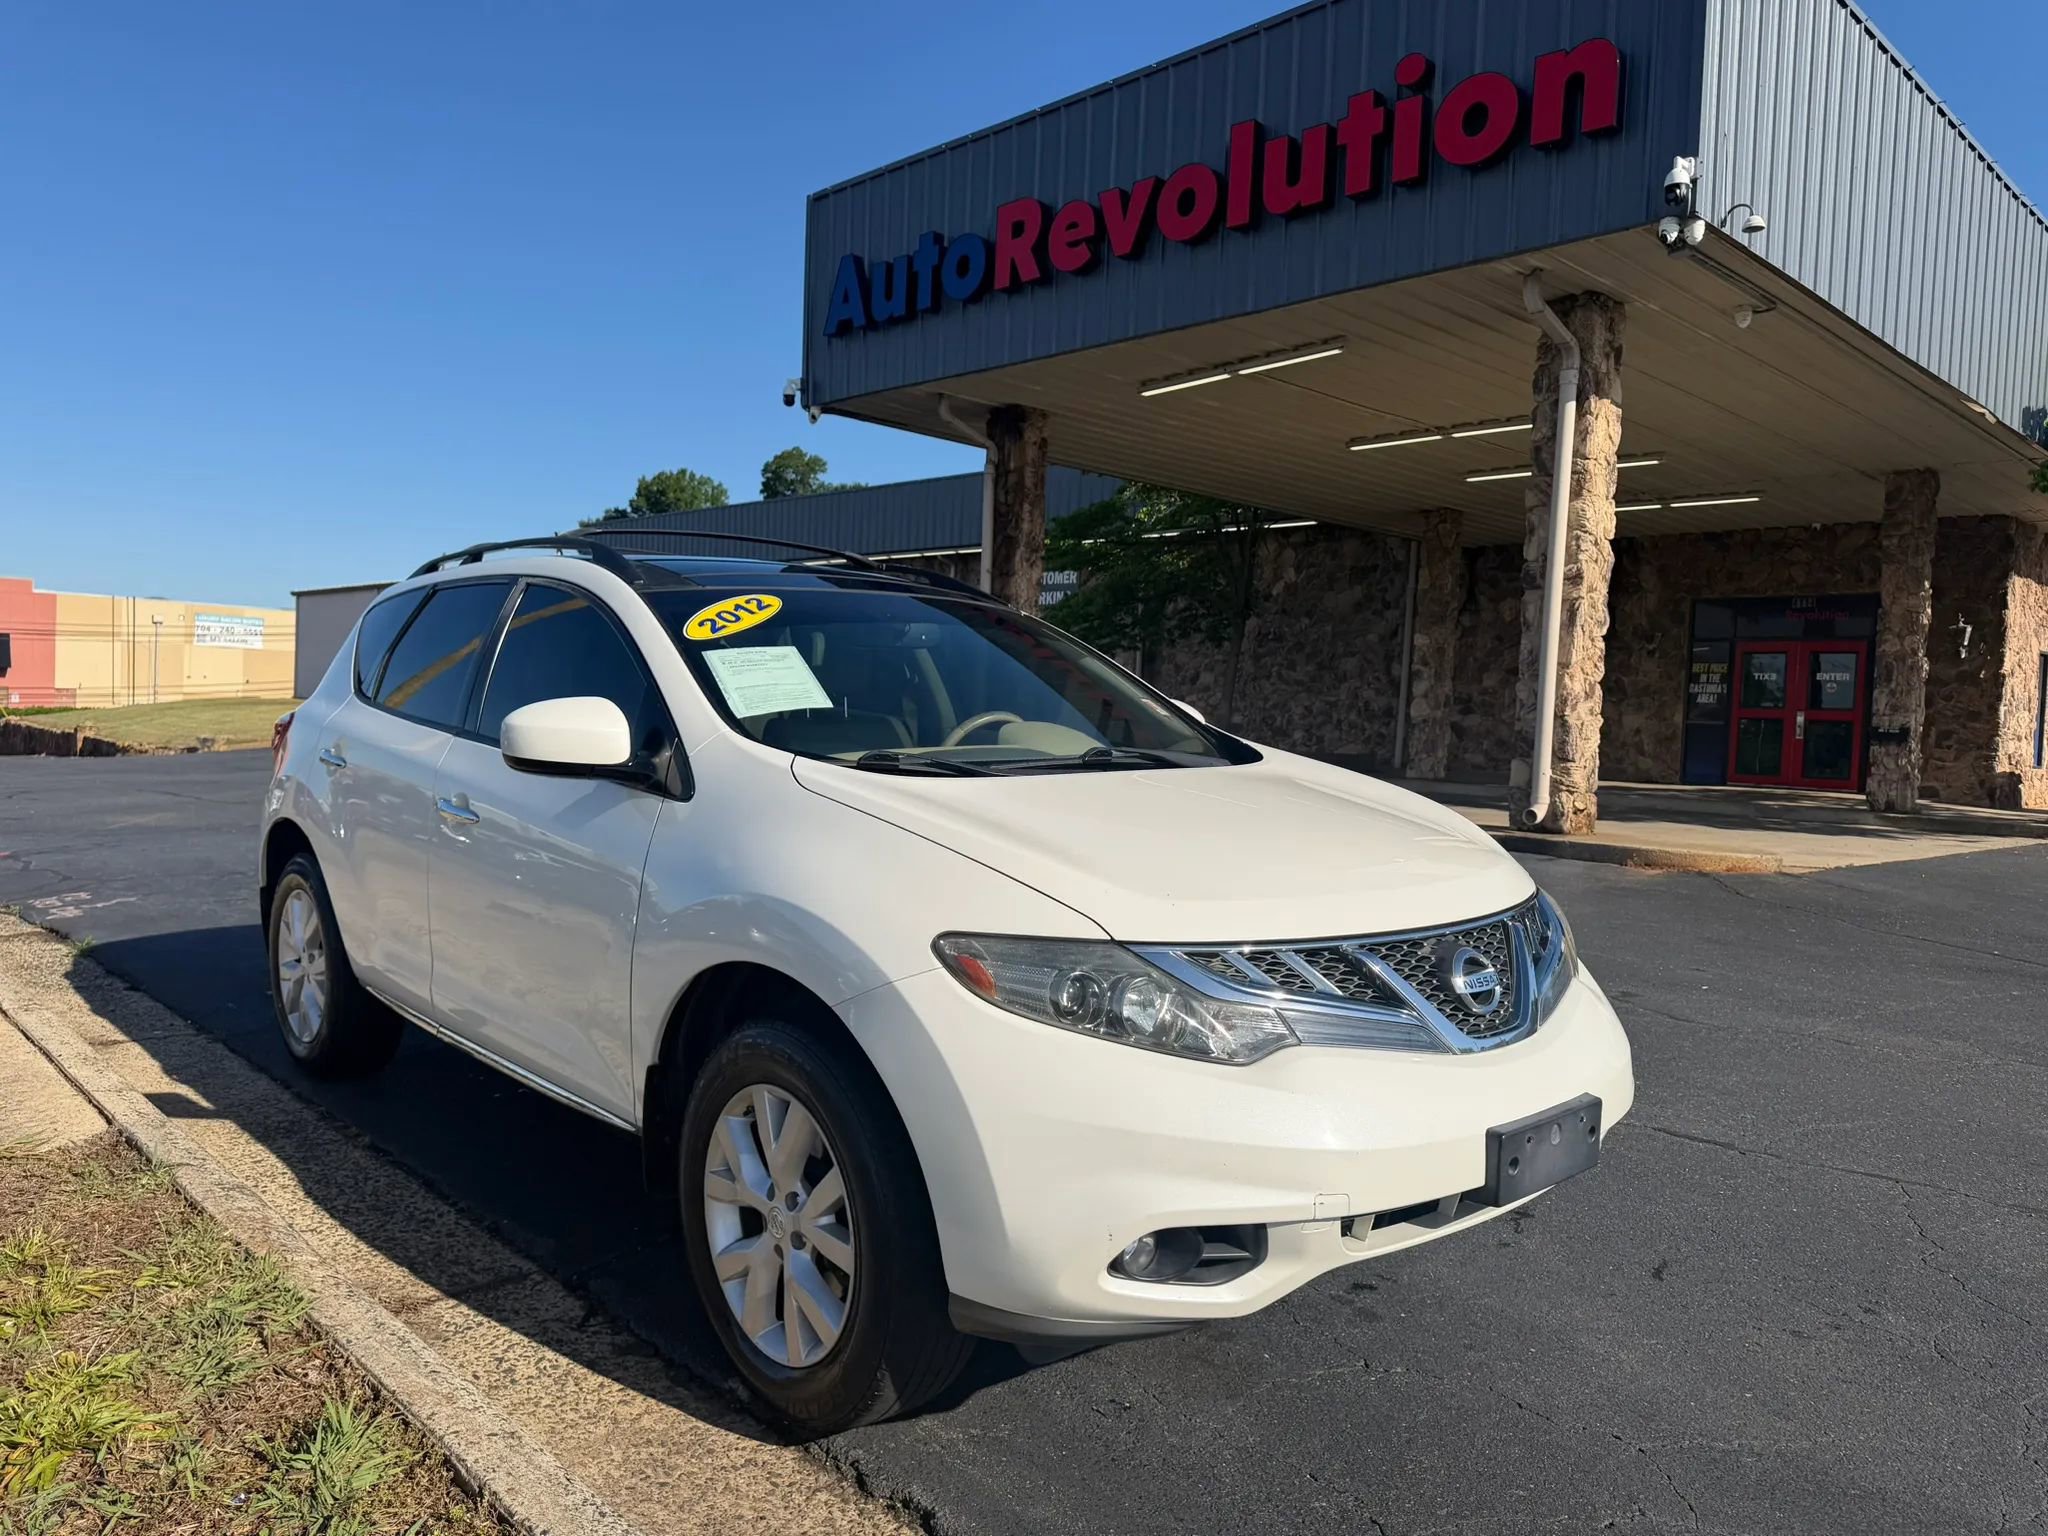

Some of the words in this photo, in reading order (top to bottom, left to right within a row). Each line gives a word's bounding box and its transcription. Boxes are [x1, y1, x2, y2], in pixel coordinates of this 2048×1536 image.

[1041, 570, 1078, 585] TOMER
[1039, 590, 1071, 605] RKIN
[698, 597, 774, 634] 2012
[1816, 672, 1850, 681] ENTER
